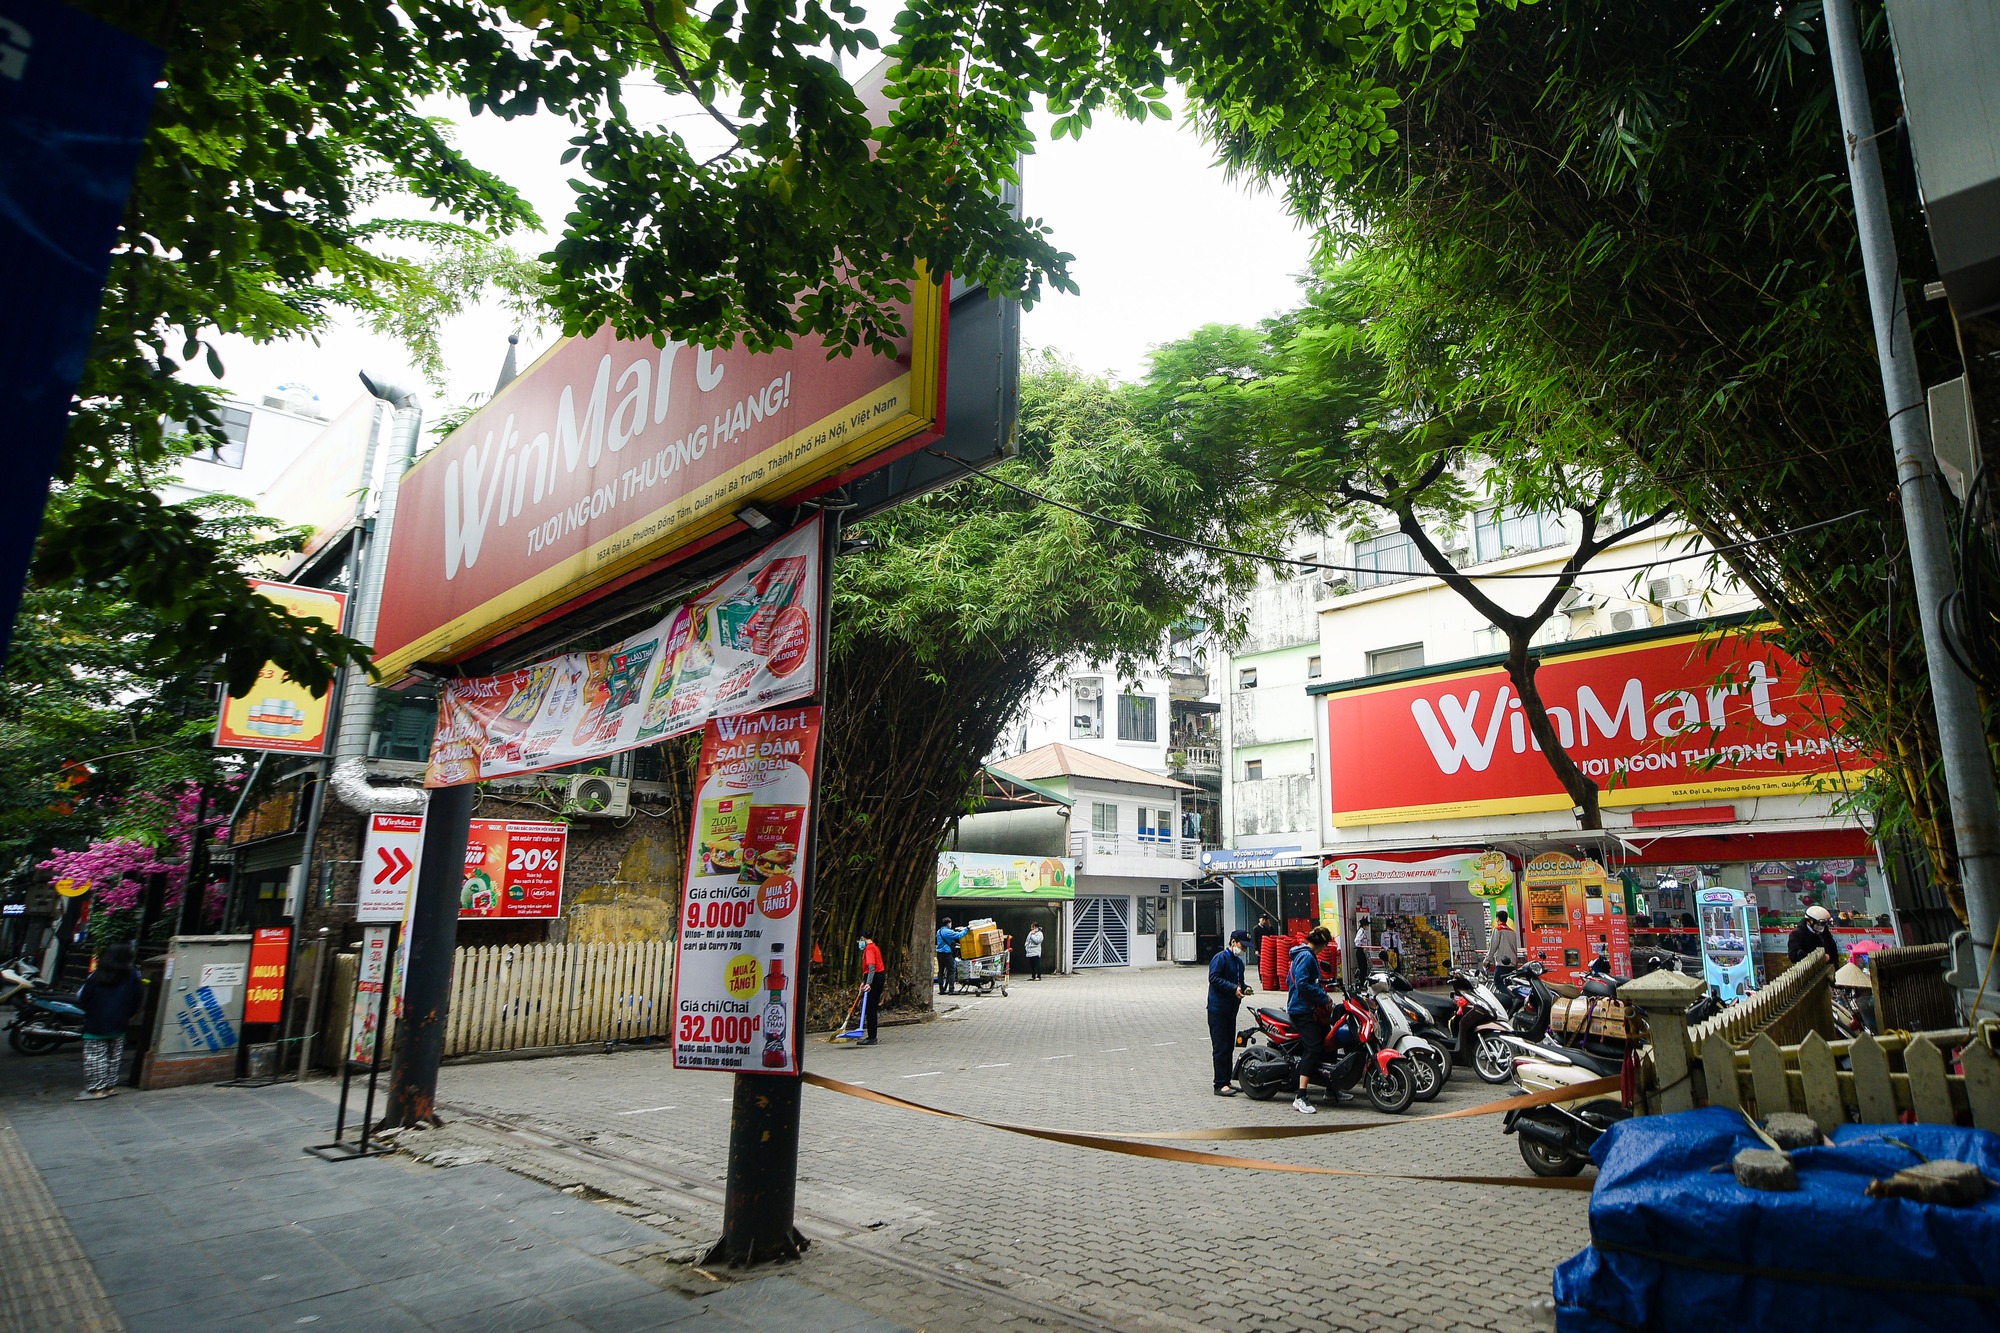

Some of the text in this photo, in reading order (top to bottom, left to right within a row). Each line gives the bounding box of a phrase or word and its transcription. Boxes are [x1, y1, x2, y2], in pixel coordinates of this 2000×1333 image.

[565, 478, 620, 533] NGON
[621, 424, 708, 503] THƯỢNG
[712, 370, 792, 450] HẠNG!
[677, 506, 693, 520] Tâm,
[694, 494, 713, 511] Quận
[714, 485, 727, 501] Hai
[728, 479, 738, 492] Bà
[740, 466, 765, 487] Trưng,
[768, 449, 793, 471] Thành
[794, 436, 813, 459] phố
[814, 431, 827, 447] Hà
[828, 420, 848, 439] Nội,
[850, 409, 871, 428] Việt
[872, 396, 897, 417] Nam
[715, 711, 808, 742] WinMart
[716, 738, 800, 762] SALE ĐẬM
[759, 758, 791, 771] DEAL
[1573, 757, 1610, 777] ƯƠI
[1614, 751, 1677, 774] NGON
[1689, 788, 1701, 796] Đại
[1713, 785, 1740, 793] Phường
[1762, 782, 1780, 790] Tâm,
[377, 816, 417, 827] WinMart
[711, 815, 737, 827] ZLOTA
[507, 848, 559, 871] 20%
[1211, 859, 1228, 871] CÔNG
[1229, 860, 1238, 869] TY
[1527, 859, 1582, 871] NƯỚC CAM
[1345, 862, 1359, 881] 3
[1405, 869, 1437, 878] NEPTUNE
[689, 887, 707, 900] Giá
[765, 880, 793, 898] MUA 3
[686, 898, 756, 929] 9.000đ
[708, 942, 728, 951] Curry
[252, 966, 279, 979] MUA
[279, 965, 286, 978] 1
[733, 960, 757, 977] MUA 2
[247, 985, 285, 1005] TẶNG 1
[680, 1000, 699, 1012] Giá
[679, 1014, 761, 1045] 32.000đ
[766, 1021, 784, 1029] THAN
